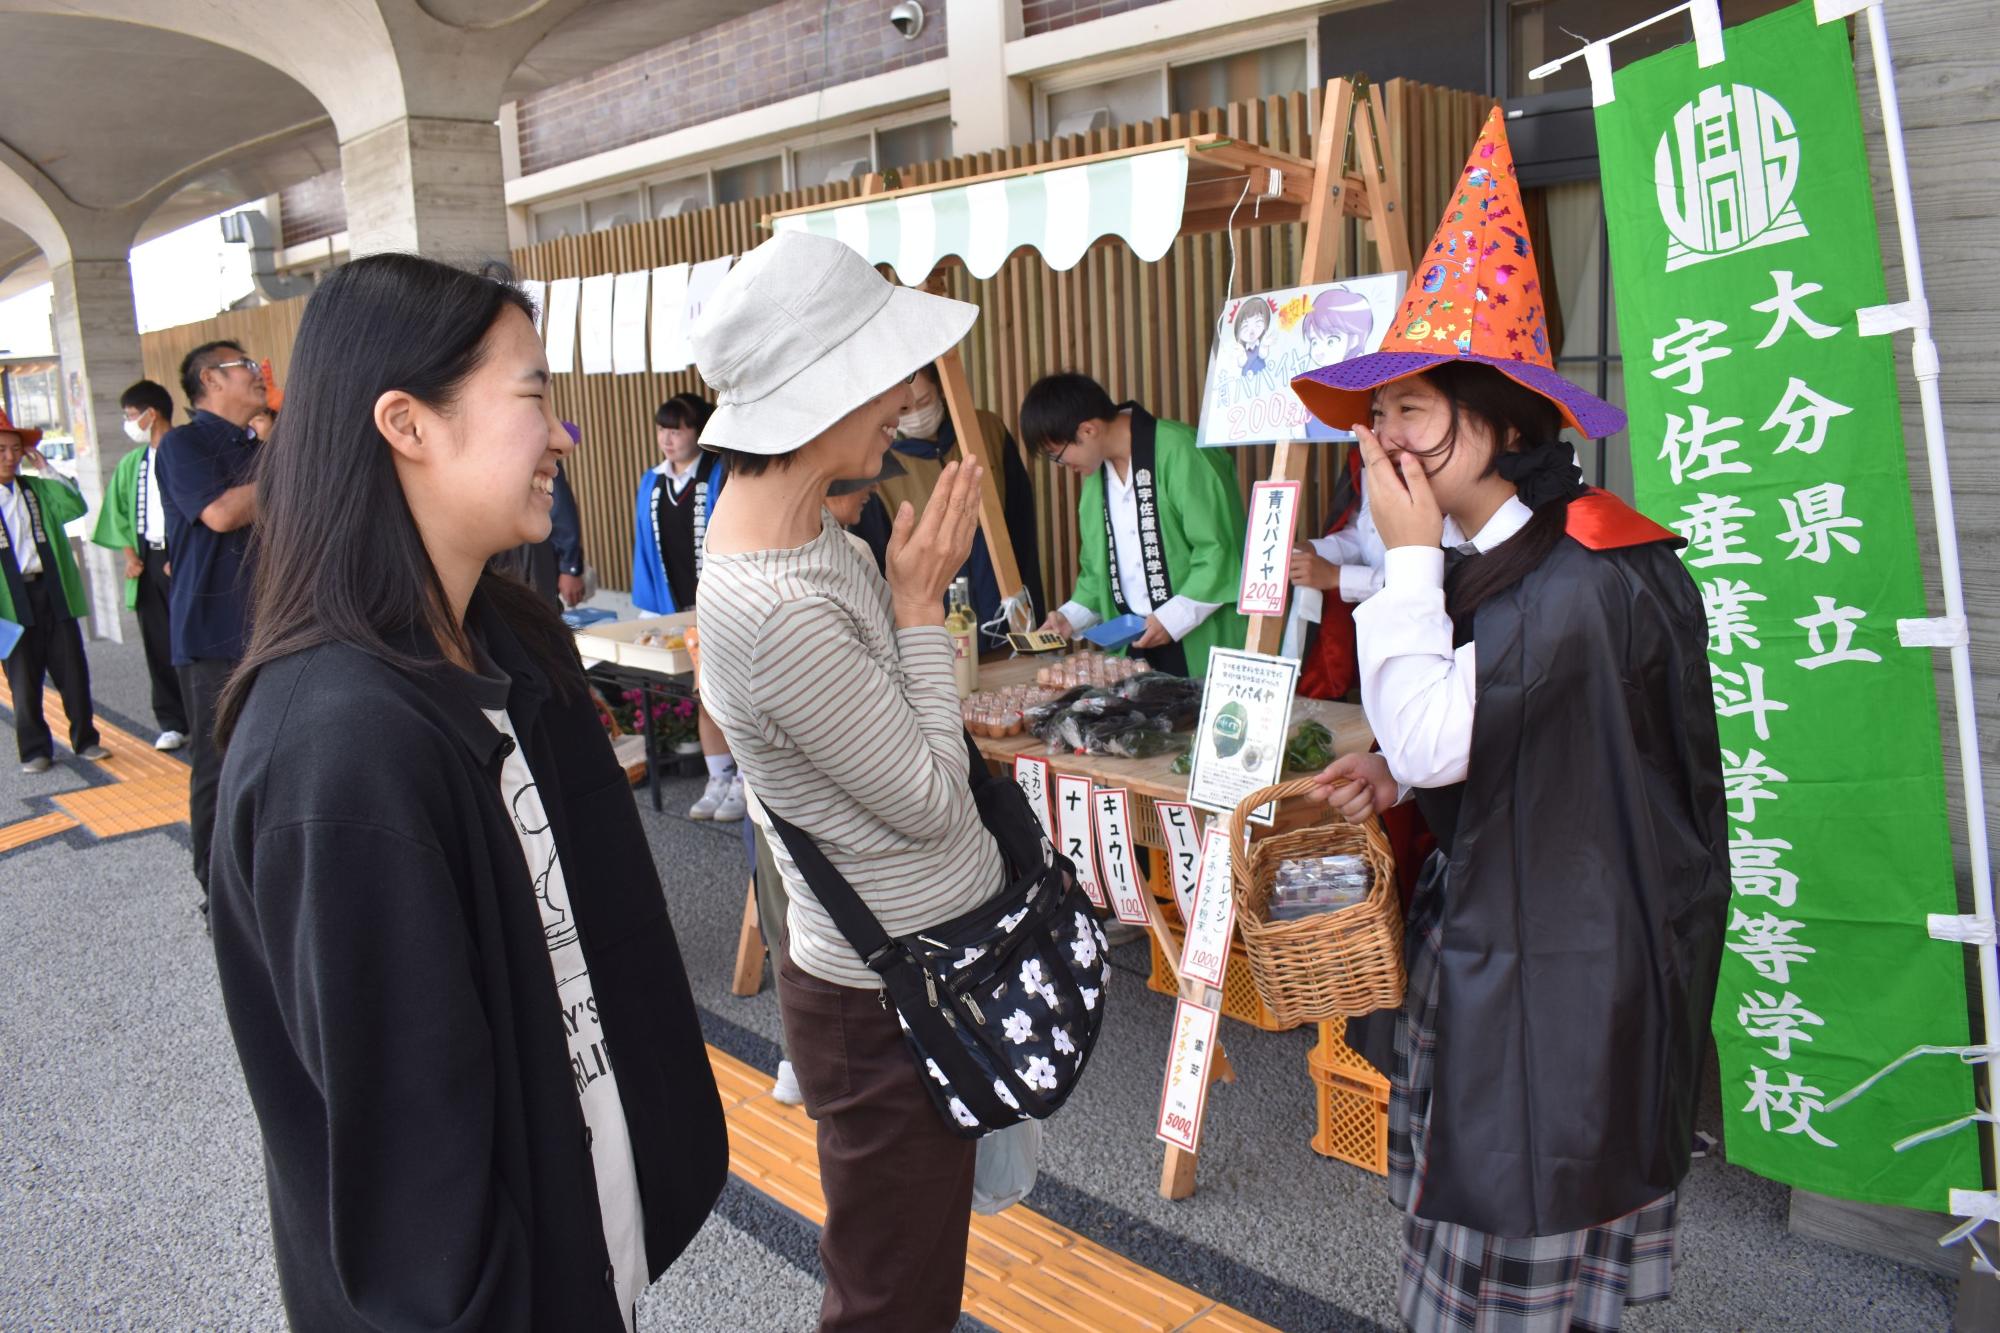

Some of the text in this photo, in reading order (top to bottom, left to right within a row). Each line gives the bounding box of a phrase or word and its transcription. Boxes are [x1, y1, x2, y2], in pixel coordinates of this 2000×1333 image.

[1750, 269, 1882, 670] 大分県立
[1138, 487, 1168, 602] 宇佐産業科学高校
[1259, 489, 1284, 582] 青パパイヤ
[1245, 582, 1281, 609] 200円
[1031, 763, 1042, 801] ミカン
[1065, 790, 1084, 859] ナス
[1103, 795, 1125, 884] キュウリ
[1168, 807, 1196, 894] ピーマン
